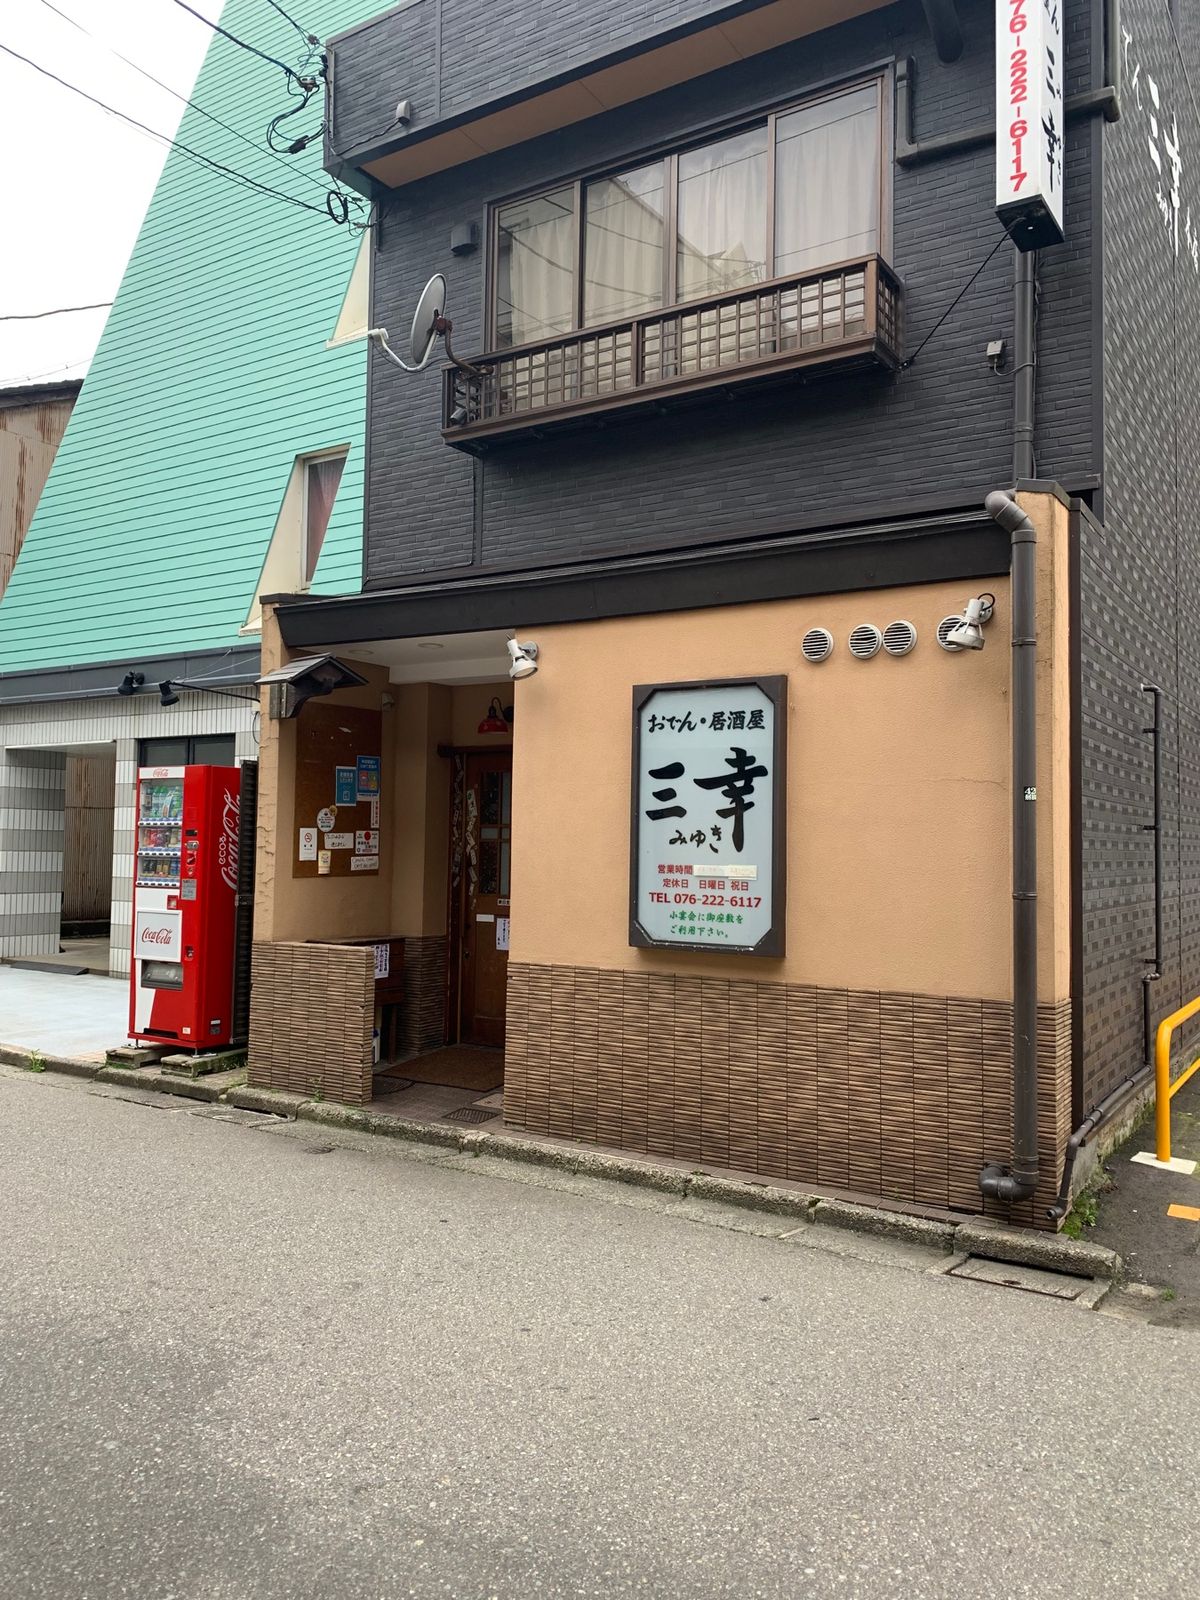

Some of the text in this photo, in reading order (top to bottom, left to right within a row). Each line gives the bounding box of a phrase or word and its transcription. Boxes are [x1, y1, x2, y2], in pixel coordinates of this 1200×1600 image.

[1041, 46, 1058, 193] 三幸
[1147, 74, 1183, 258] 三幸
[648, 709, 766, 733] おでん・居酒屋
[645, 747, 768, 853] 三幸
[669, 825, 722, 853] みゆき
[657, 864, 694, 875] 営業時間
[662, 878, 749, 891] 定休日 日曜日 祝日
[649, 892, 762, 908] TEL 076-222-6117
